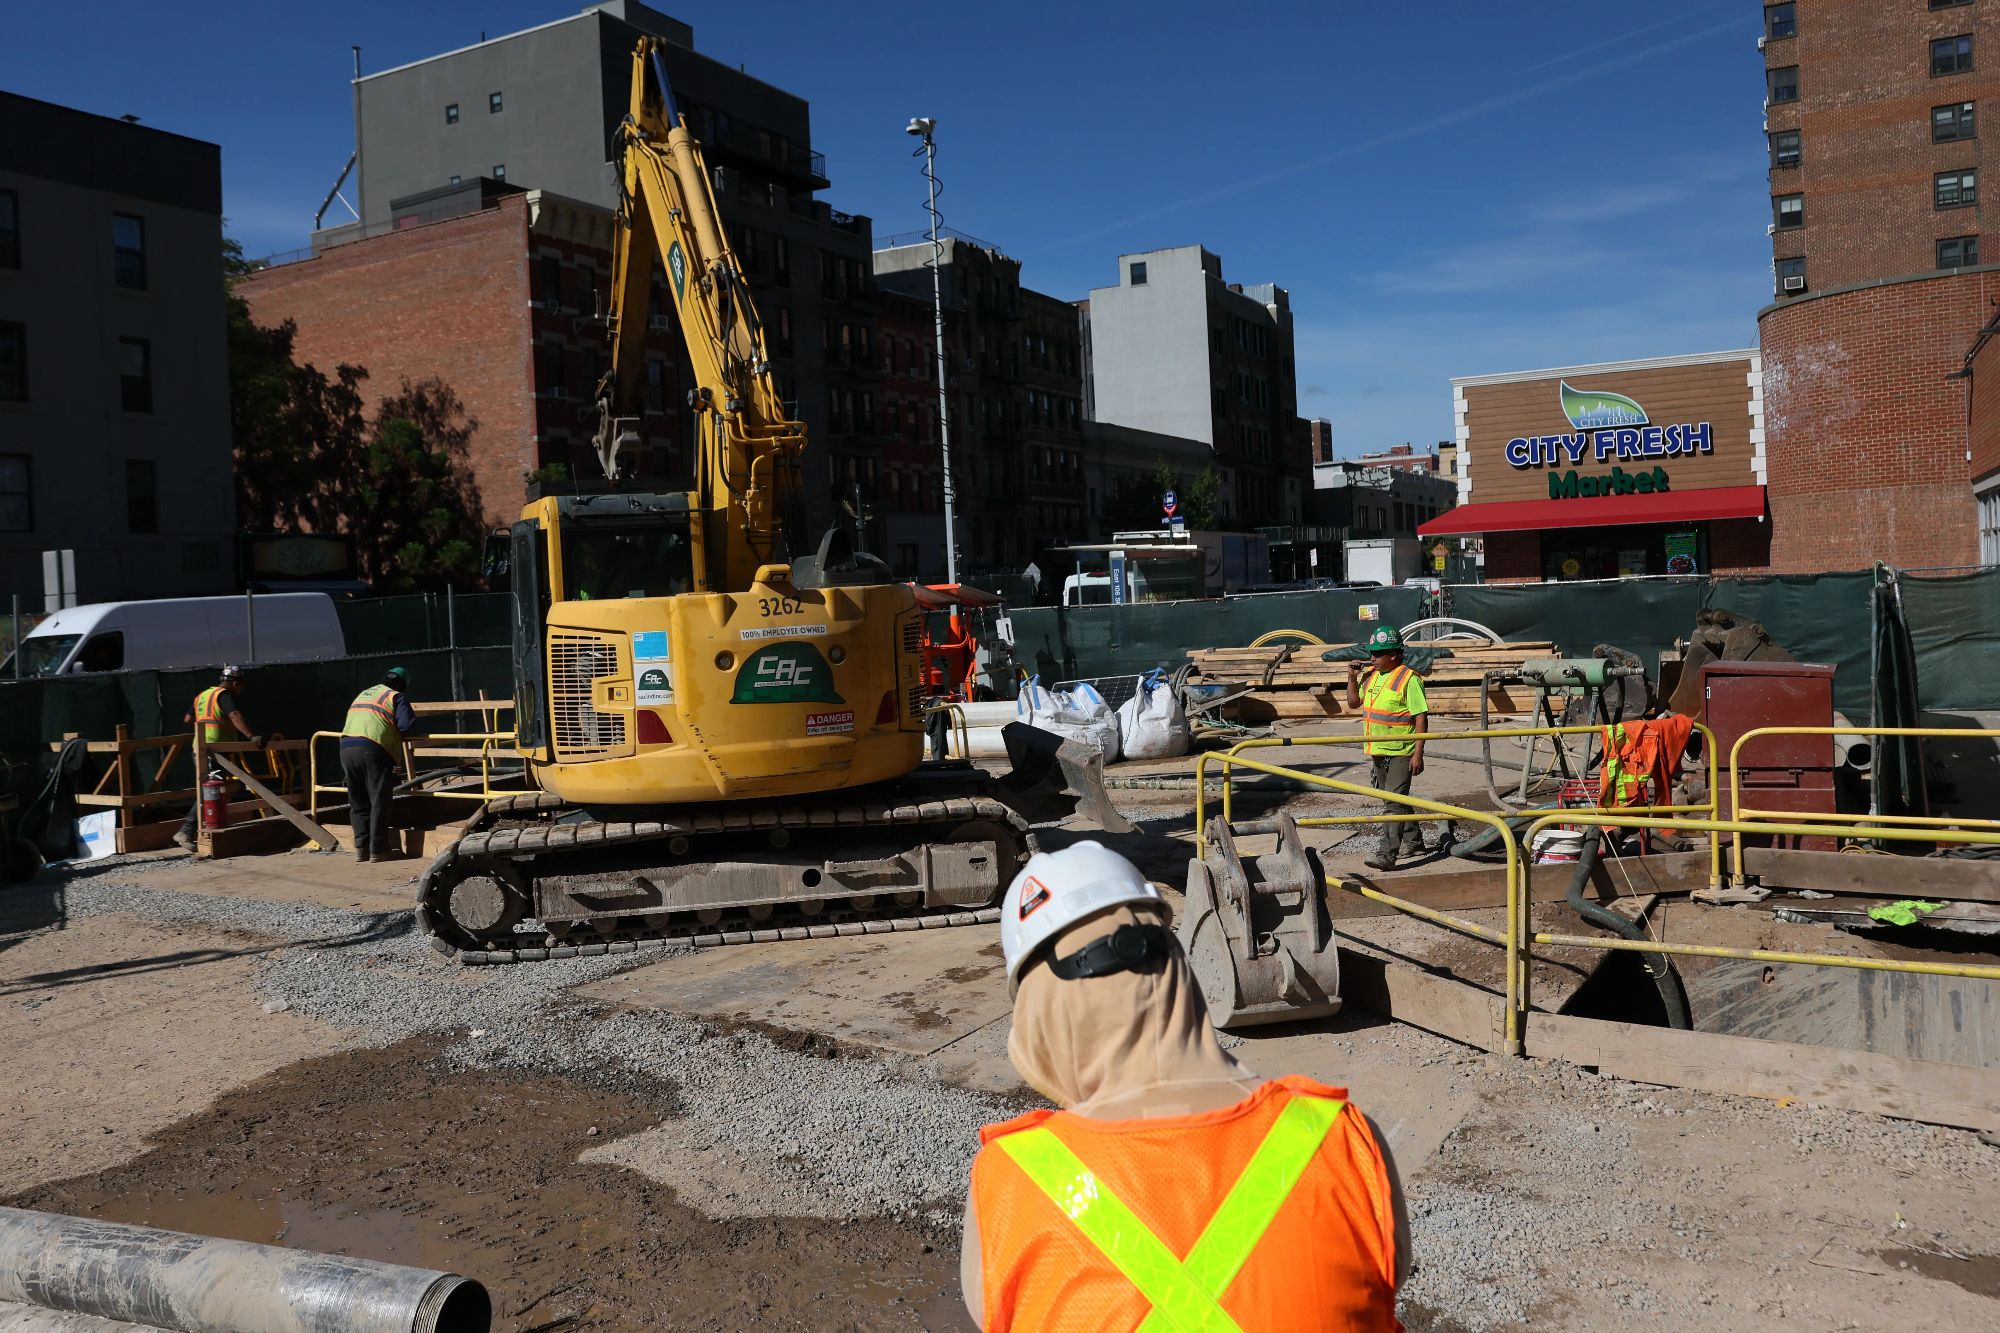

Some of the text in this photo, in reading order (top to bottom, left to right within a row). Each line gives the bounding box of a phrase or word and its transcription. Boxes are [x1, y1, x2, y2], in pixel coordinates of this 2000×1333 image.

[1580, 415, 1638, 427] CITY FRESH
[1505, 422, 1711, 466] CITY FRESH
[1548, 465, 1670, 500] Market
[758, 596, 805, 617] 3262
[742, 626, 826, 639] 100% EMPLOYEE OWNED
[644, 673, 663, 685] CAC
[756, 656, 813, 686] CAC
[816, 712, 853, 724] DANGER
